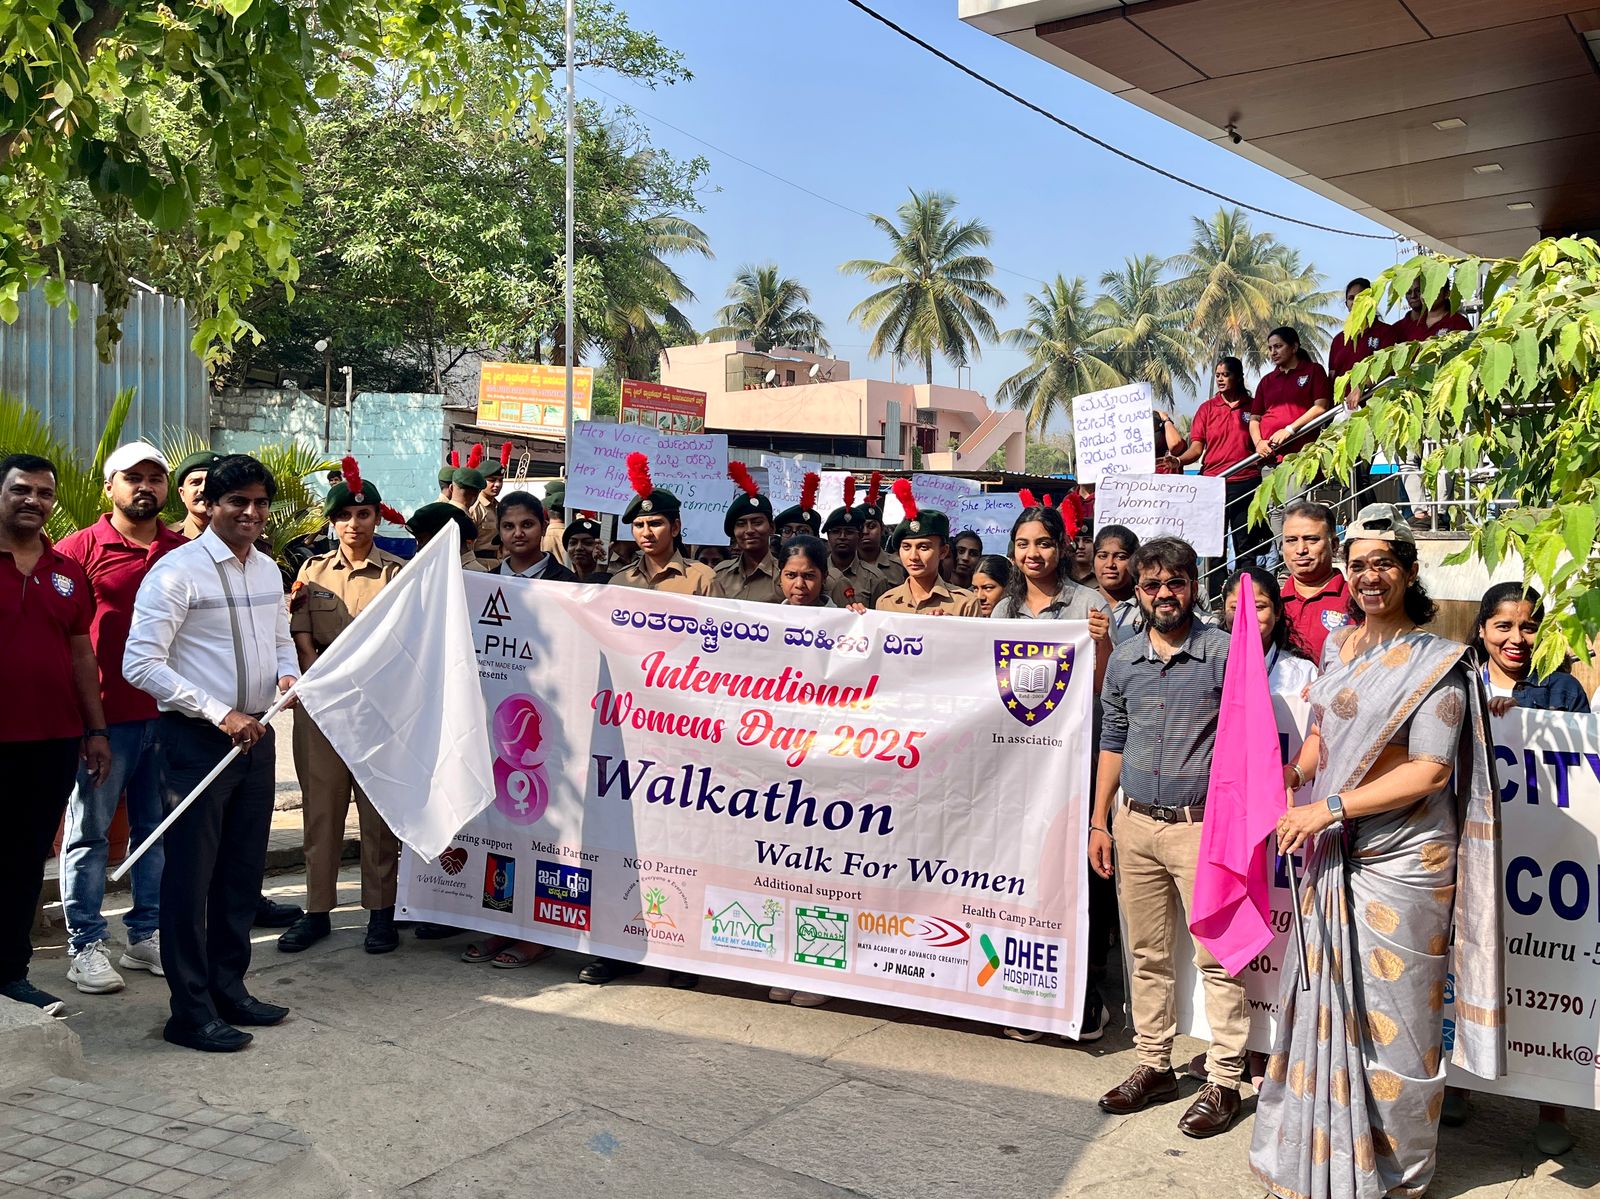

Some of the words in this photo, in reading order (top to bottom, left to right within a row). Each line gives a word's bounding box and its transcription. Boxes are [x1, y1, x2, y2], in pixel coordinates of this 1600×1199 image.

[580, 424, 606, 437] Her
[614, 428, 650, 445] Voice
[574, 462, 598, 476] Her
[915, 475, 971, 495] Celebrating
[1100, 477, 1197, 503] Empowering
[961, 500, 979, 512] She
[1118, 496, 1170, 509] Women
[1098, 510, 1185, 536] Empowering
[611, 609, 769, 653] ಅಂತರಾಷ್ಟ್ರೀಯ
[883, 634, 923, 656] ದಿನ
[1000, 643, 1068, 659] SCPUC
[479, 671, 508, 680] resents
[495, 662, 511, 670] MADE
[512, 663, 527, 671] EASY
[641, 651, 879, 709] International
[591, 689, 727, 744] Womens
[736, 708, 822, 768] Day
[828, 724, 927, 770] 2025
[992, 733, 1005, 744] In
[593, 753, 895, 836] Walkathon
[481, 837, 513, 850] support
[531, 840, 561, 855] Media
[563, 846, 600, 863] Partner
[623, 857, 652, 871] NGO
[656, 861, 698, 877] Partner
[755, 840, 832, 874] Walk
[841, 852, 897, 883] For
[909, 856, 1026, 897] Women
[754, 876, 813, 895] Additional
[816, 885, 862, 901] support
[1505, 856, 1600, 923] CO
[539, 902, 586, 926] NEWS
[858, 911, 916, 938] MAAC
[962, 904, 996, 919] Health
[999, 910, 1026, 927] Camp
[1029, 916, 1062, 930] Parter
[623, 924, 685, 943] ABHYUDAYA
[712, 935, 728, 944] MAKE
[730, 937, 739, 945] MY
[741, 939, 767, 948] GARDEN
[713, 918, 774, 943] MMG
[858, 942, 872, 950] MAYA
[874, 945, 898, 954] ACADEMY
[908, 951, 937, 961] ADVANCED
[938, 955, 969, 966] CREATIVITY
[1004, 937, 1058, 973] DHEE
[1506, 932, 1576, 961] aluru
[882, 961, 893, 973] JP
[895, 963, 926, 978] NAGAR
[1248, 955, 1278, 974] 80-
[1003, 968, 1058, 989] HOSPITALS
